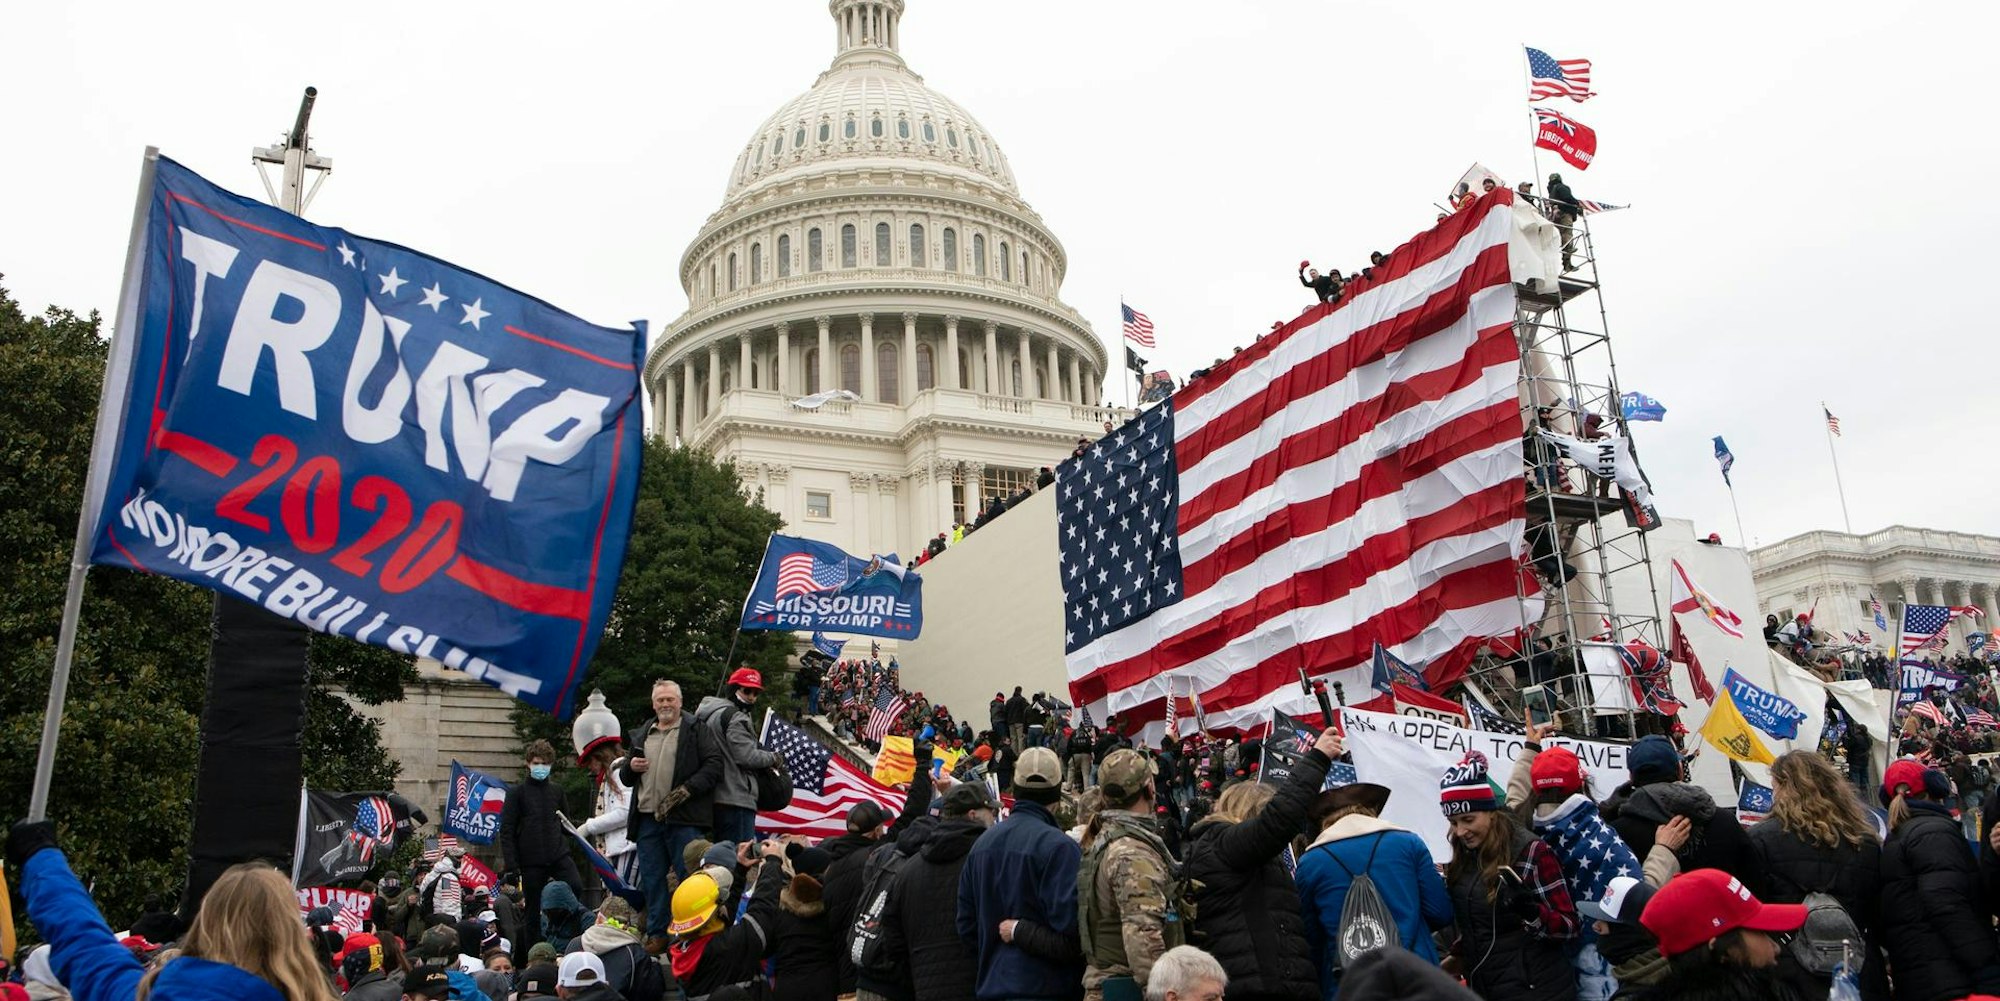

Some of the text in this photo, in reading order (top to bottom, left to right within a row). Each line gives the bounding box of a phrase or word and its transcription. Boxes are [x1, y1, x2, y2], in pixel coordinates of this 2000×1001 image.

[1574, 148, 1595, 164] UNIO
[177, 225, 612, 503] TRUMP
[215, 434, 464, 594] 2020
[119, 486, 175, 548] NO
[167, 513, 294, 602] MORE
[776, 613, 882, 629] FOR TRUMP
[1734, 680, 1800, 720] TRUMP
[1342, 712, 1376, 733] AN
[1488, 738, 1523, 762] TO
[1440, 760, 1486, 785] RUMP
[454, 806, 497, 830] TEAS
[1443, 800, 1471, 817] 020
[296, 887, 371, 917] RUMP
